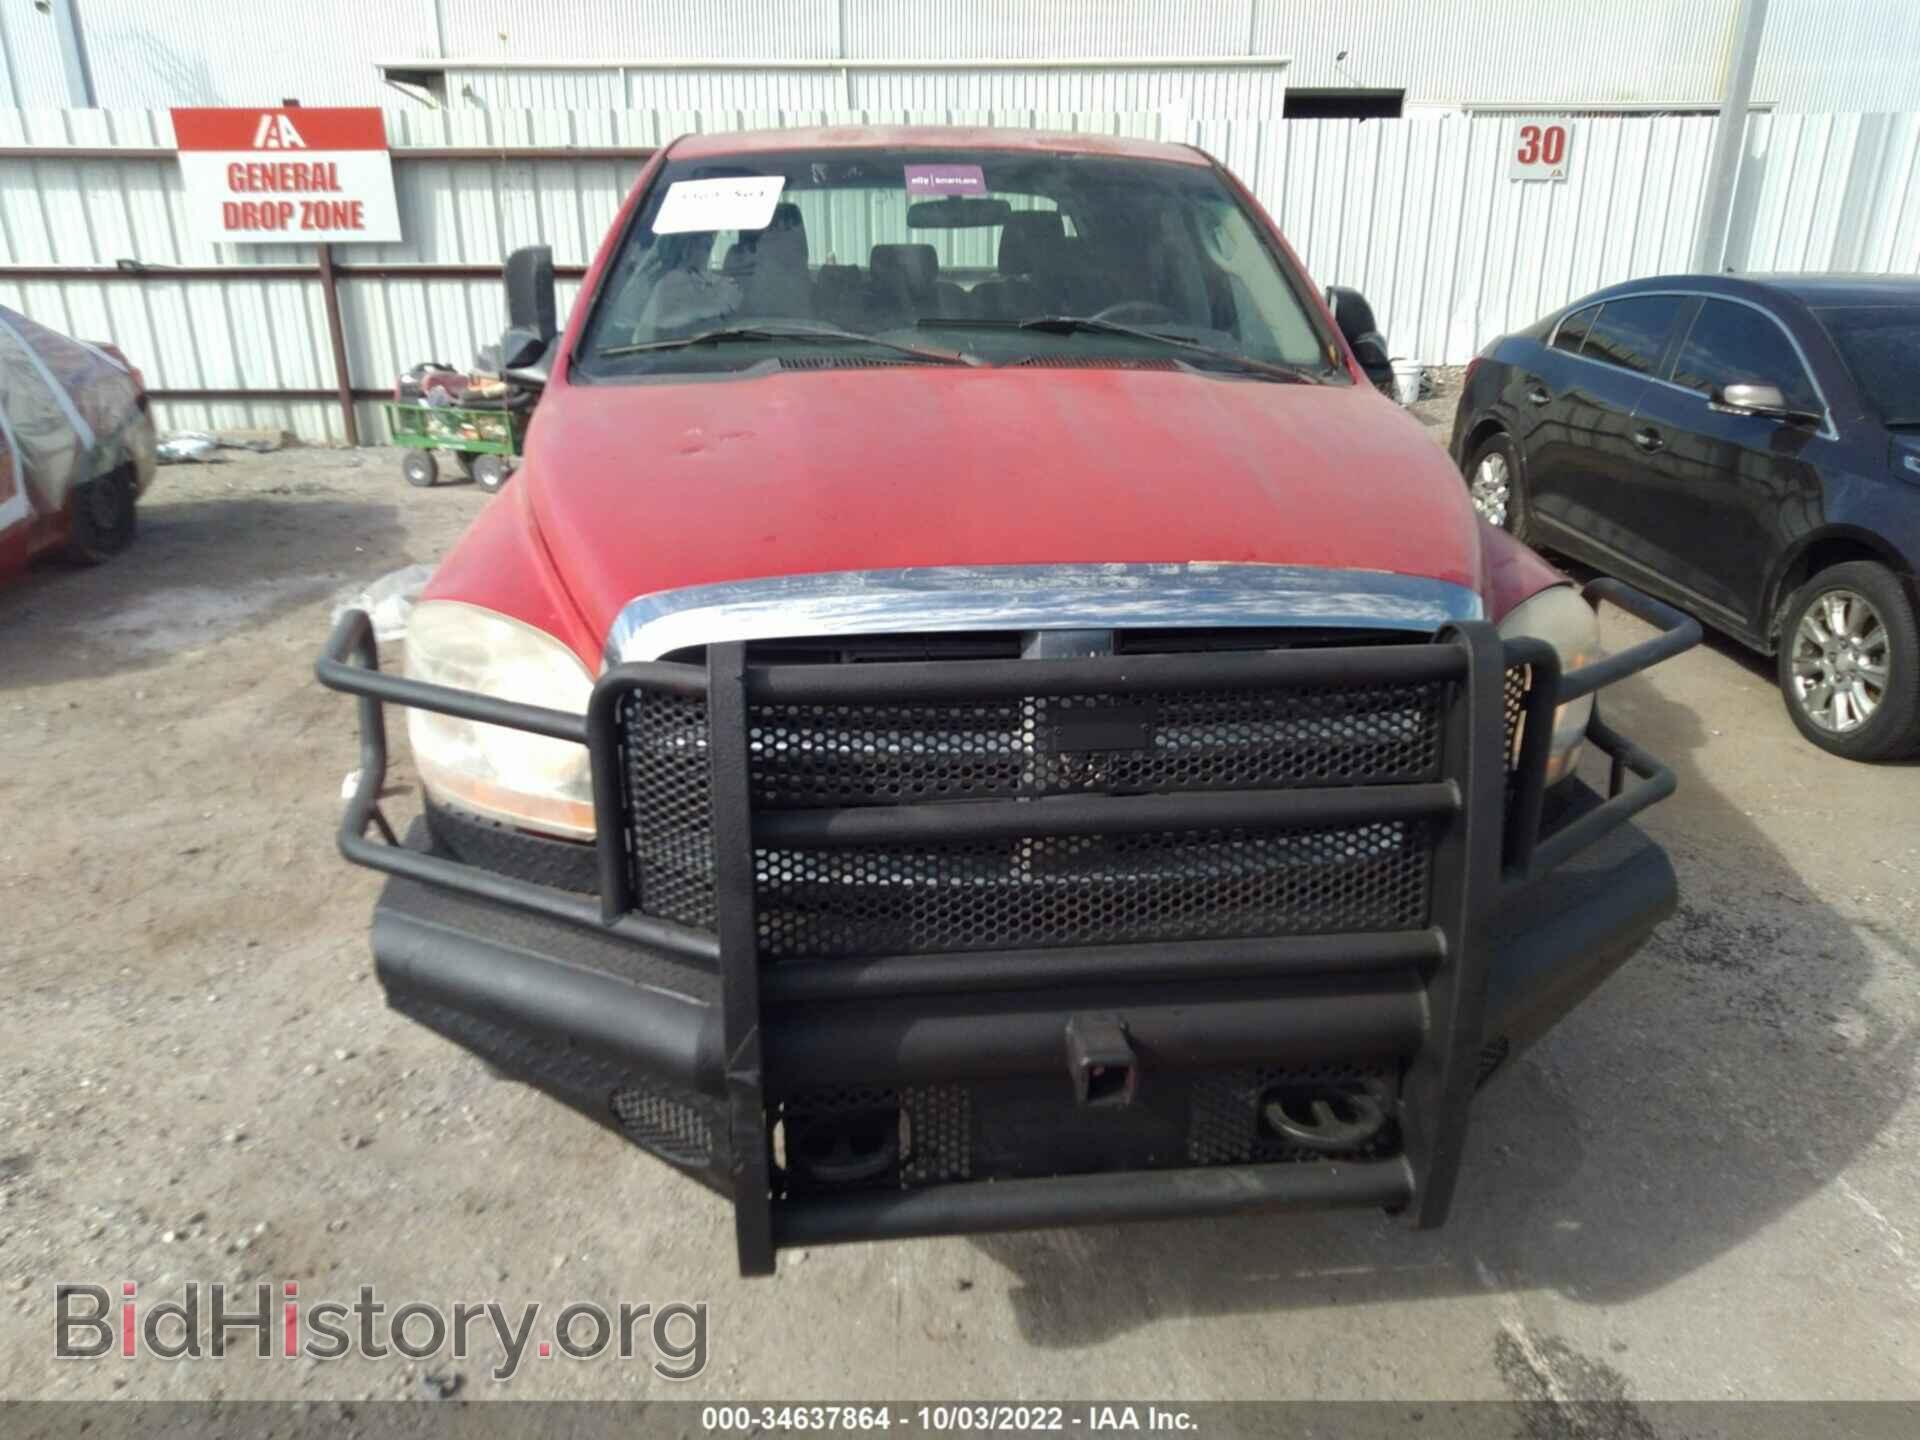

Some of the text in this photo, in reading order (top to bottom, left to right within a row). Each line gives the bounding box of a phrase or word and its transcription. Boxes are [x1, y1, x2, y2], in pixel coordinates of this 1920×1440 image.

[1518, 125, 1566, 165] 30
[227, 162, 342, 193] GENERAL
[222, 200, 365, 231] DROP ZONE
